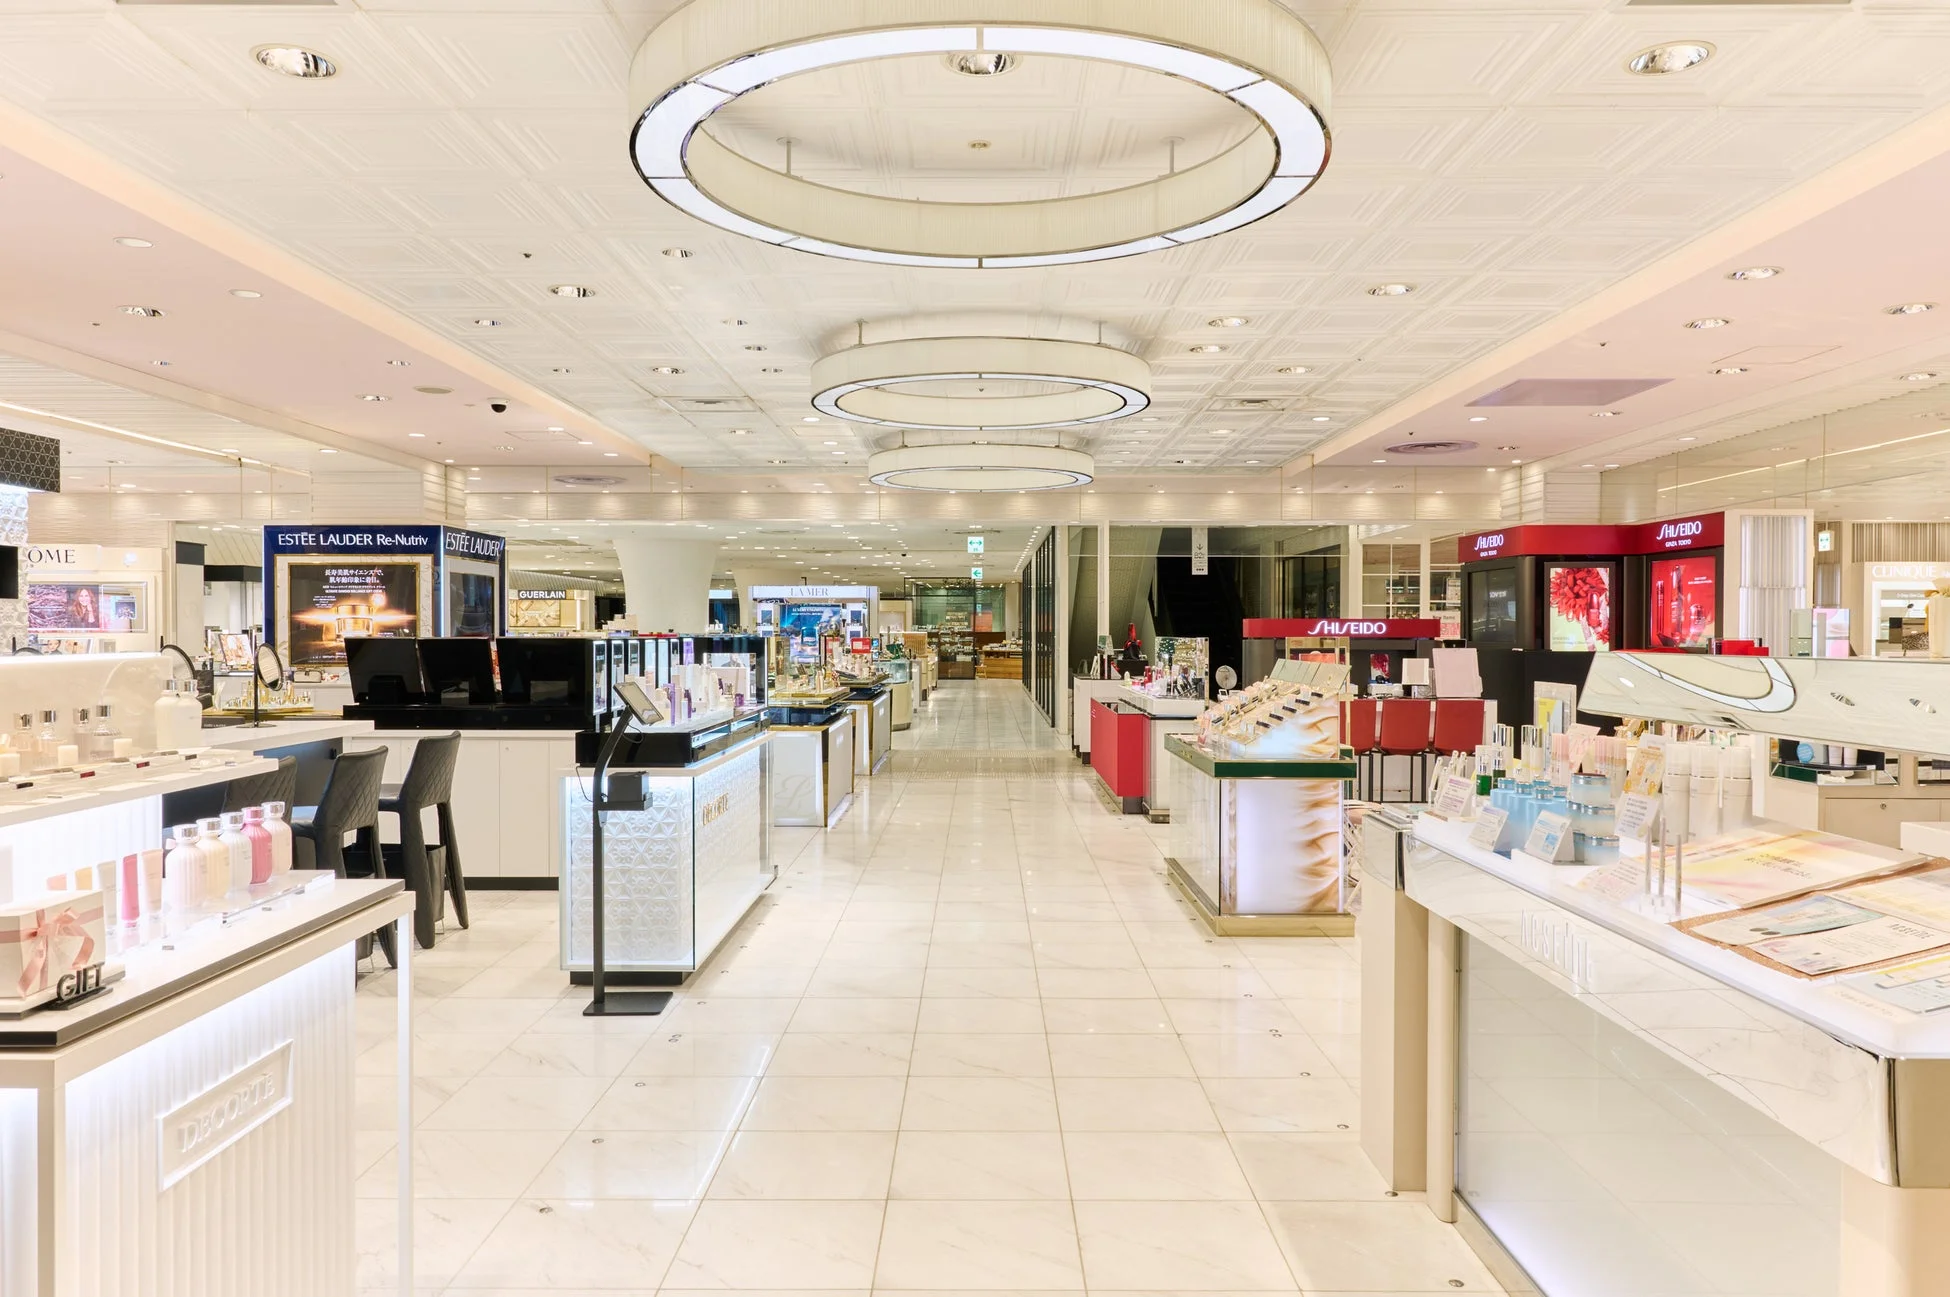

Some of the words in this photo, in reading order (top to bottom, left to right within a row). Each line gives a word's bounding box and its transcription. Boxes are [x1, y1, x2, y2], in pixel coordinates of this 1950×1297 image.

[1656, 521, 1702, 540] SHISEIDO
[320, 533, 373, 546] LAUDER
[377, 533, 429, 546] Re-Nutriv
[470, 537, 500, 557] LAUDER
[1474, 534, 1504, 550] SHISEIDO
[1872, 565, 1936, 578] CLINIQUE
[806, 588, 830, 596] MER
[1307, 620, 1386, 635] SHISEIDO
[56, 962, 105, 1001] GIFT
